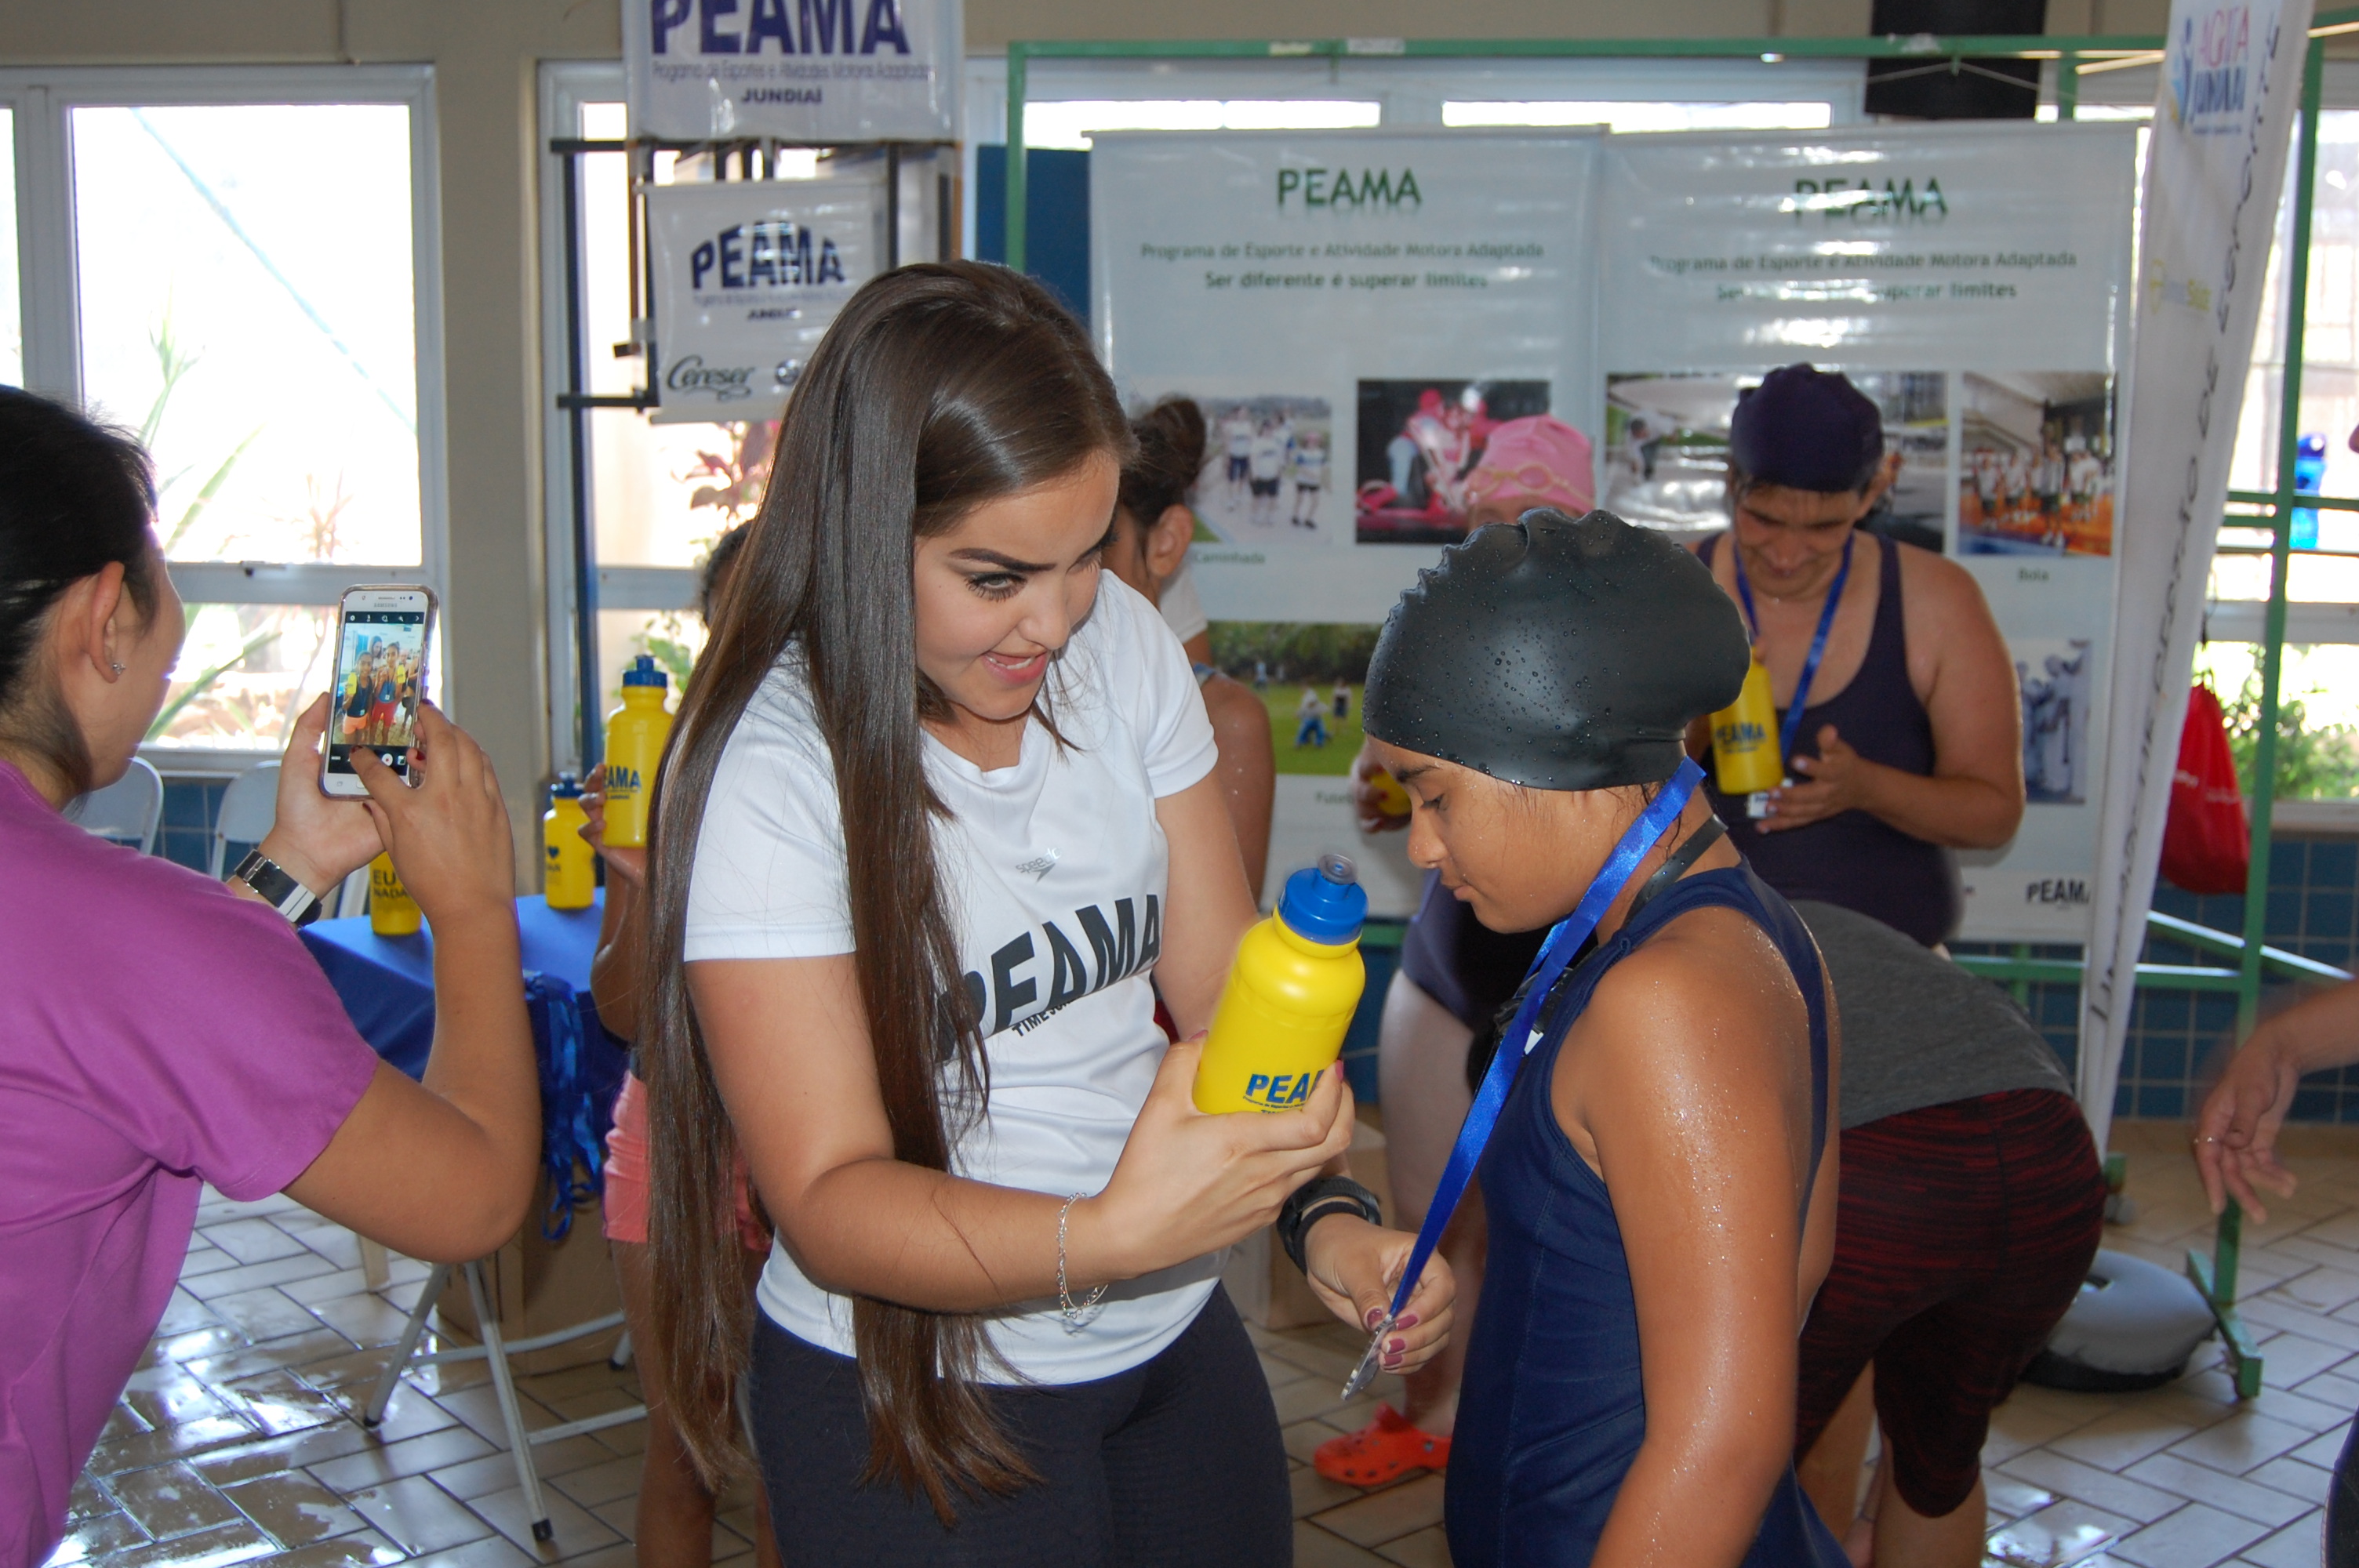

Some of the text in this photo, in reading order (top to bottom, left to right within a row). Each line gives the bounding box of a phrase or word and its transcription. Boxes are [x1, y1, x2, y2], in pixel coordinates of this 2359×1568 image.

[652, 0, 911, 55] PEAMA
[1278, 168, 1423, 207] PEAMA
[1796, 178, 1949, 216] PEAMA
[690, 220, 845, 289] PEAMA
[1142, 241, 1544, 262] Programa de Esporte e Atividade Motora Adaptada
[1649, 250, 2077, 274] Programa de Esporte e Atividade Motora Adaptada
[1205, 271, 1233, 288] Ser
[1241, 271, 1325, 288] diferente
[1349, 274, 1417, 292] superar
[1425, 271, 1488, 288] limites
[1874, 287, 1943, 302] uperar
[1950, 282, 2017, 299] limites
[373, 869, 396, 886] EU
[373, 887, 407, 898] NADA
[2026, 878, 2091, 903] PEAM
[1011, 1010, 1050, 1037] TIME
